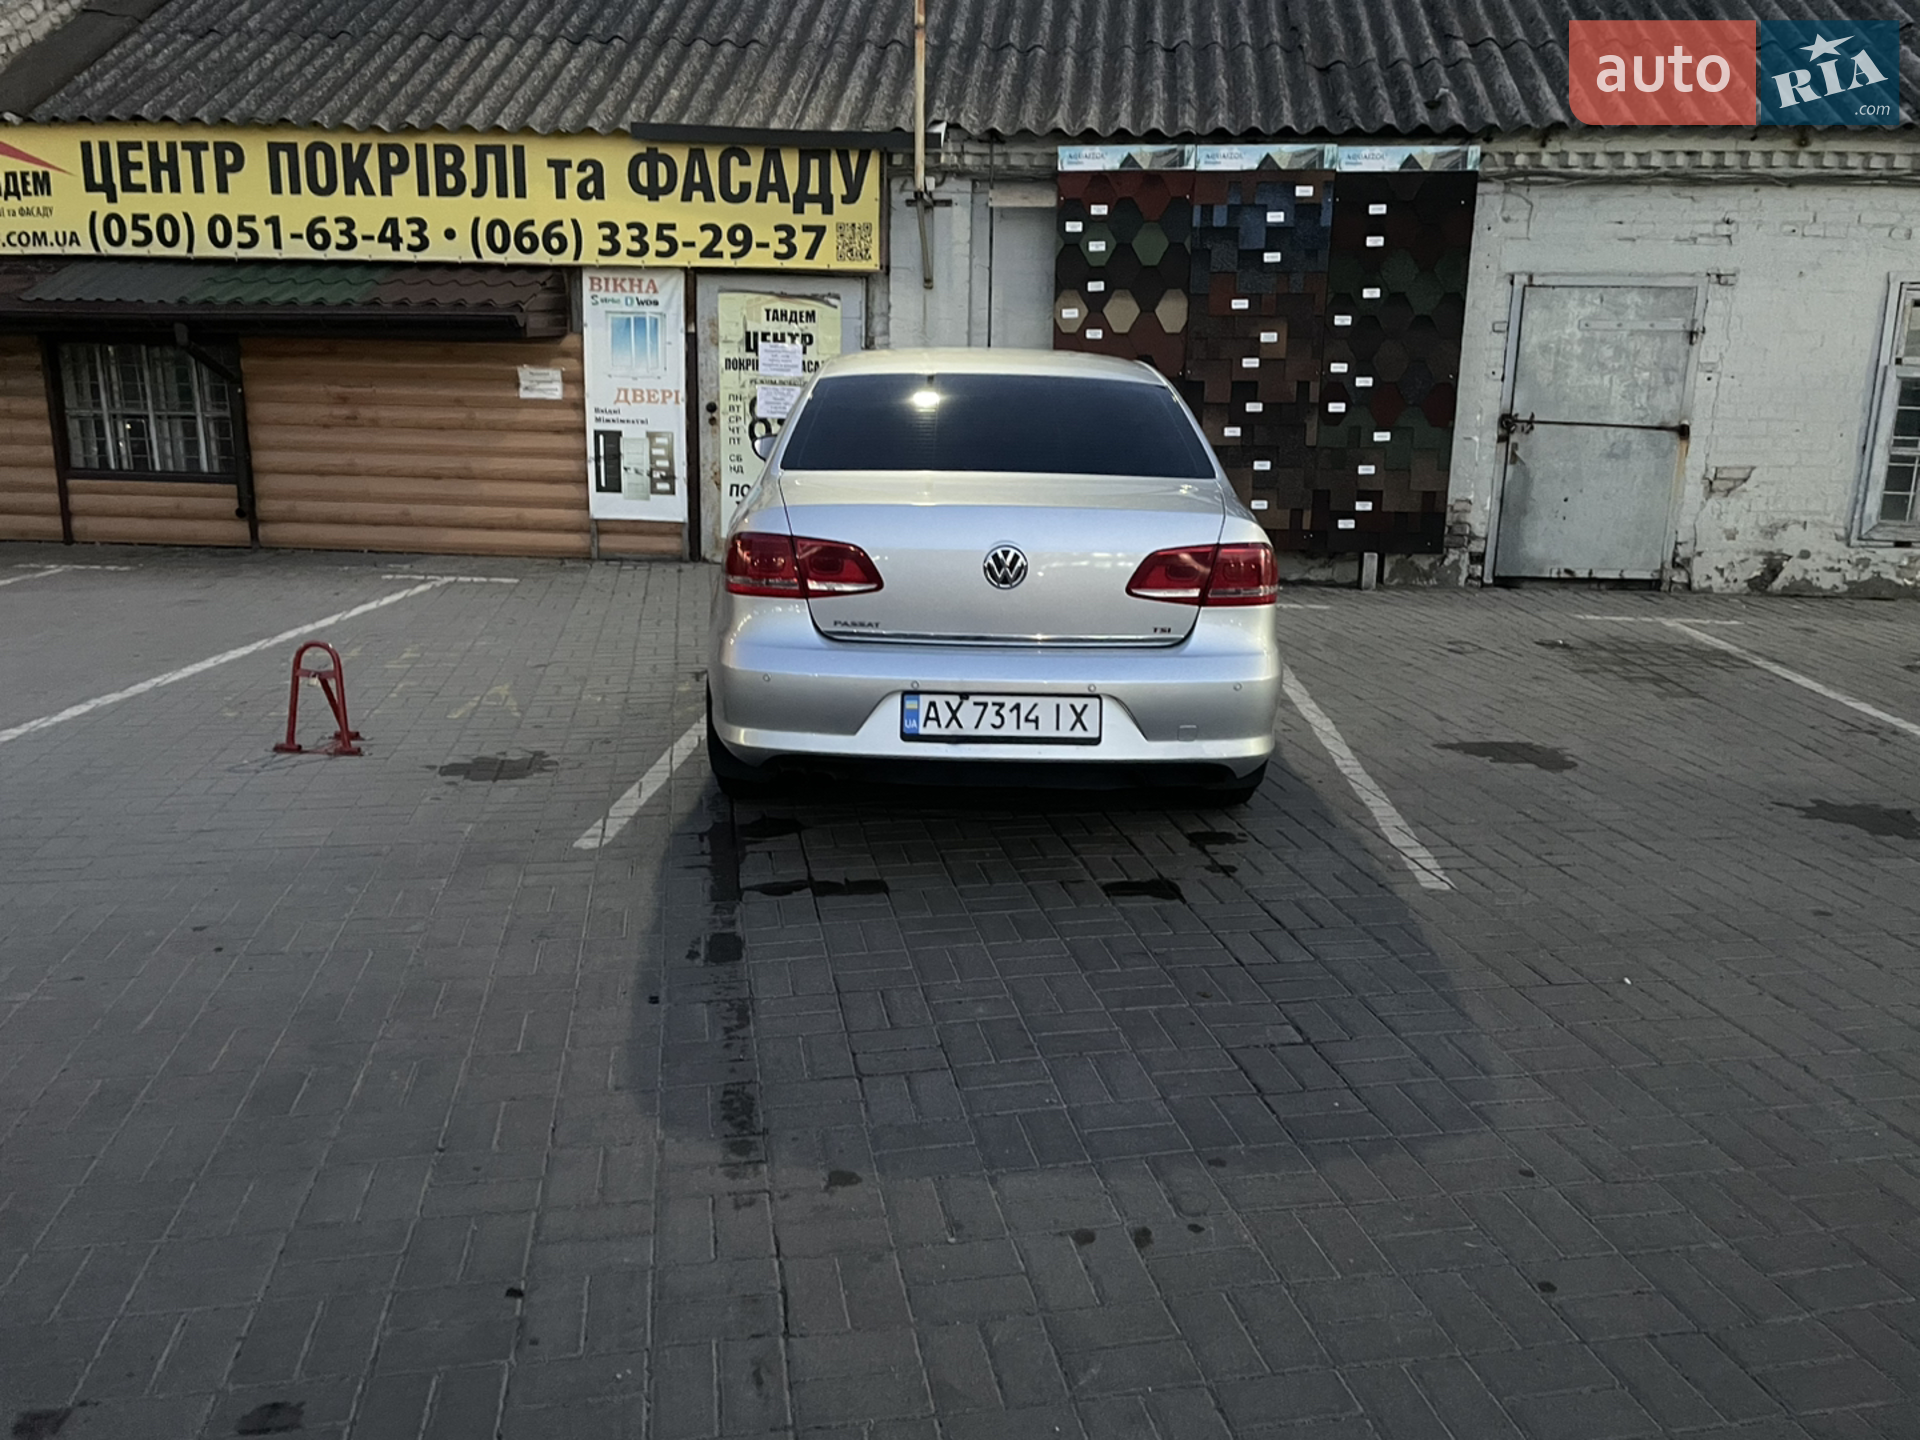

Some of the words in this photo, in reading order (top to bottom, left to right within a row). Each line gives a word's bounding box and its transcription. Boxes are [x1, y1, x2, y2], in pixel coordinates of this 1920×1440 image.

[0, 170, 52, 202] ДЕМ
[80, 140, 246, 204] ЦЕНТР
[267, 140, 527, 199] ПОКРІВЛІ
[546, 158, 605, 201] та
[627, 147, 873, 215] ФАСАДУ
[89, 211, 194, 254] (050)
[207, 214, 430, 252] 051-63-43
[471, 216, 584, 260] (066)
[597, 221, 827, 260] 335-29-37
[588, 276, 659, 294] ВІКНА
[765, 308, 816, 325] ТАНДЕМ
[613, 387, 680, 406] ДВЕРІ
[833, 620, 881, 629] PASSAT
[904, 719, 918, 729] UA
[922, 701, 965, 729] AX
[972, 702, 1040, 731] 7314
[1054, 704, 1089, 731] IX
